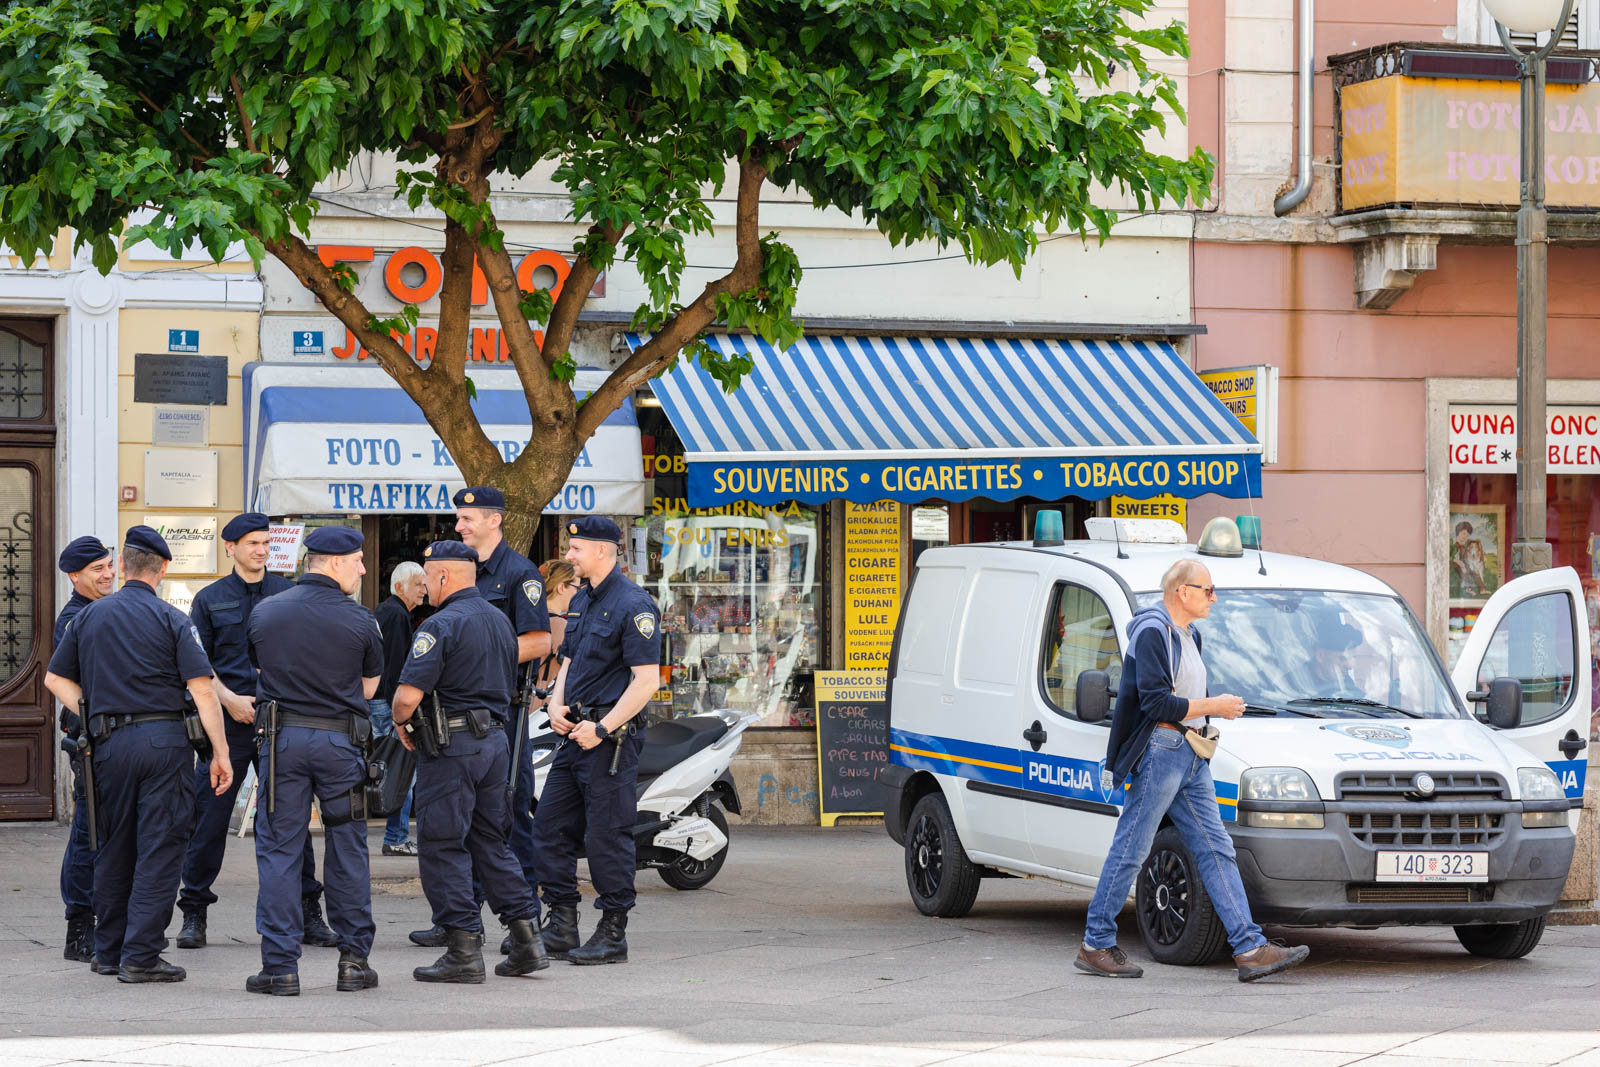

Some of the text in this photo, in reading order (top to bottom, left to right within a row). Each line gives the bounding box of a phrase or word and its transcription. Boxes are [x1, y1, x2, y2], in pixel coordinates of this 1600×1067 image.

[1344, 102, 1385, 136] FOTO
[1344, 152, 1386, 187] COPY
[180, 331, 187, 345] 1
[303, 332, 313, 346] 3
[1205, 377, 1254, 393] BACCO SHOP
[1451, 414, 1598, 435] VUNA ONC
[326, 438, 401, 466] FOTO
[1449, 444, 1498, 464] IGLE
[642, 454, 688, 473] TOB
[713, 461, 1239, 494] SOUVENIRS CIGARETTES TOBACCO SHOP
[329, 483, 452, 510] TRAFIKA
[1116, 503, 1179, 516] SWEETS
[849, 558, 896, 568] CIGARE
[849, 574, 896, 582] CIGARETE
[849, 587, 897, 595] E-CIGARETE
[854, 600, 893, 608] DUHANI
[696, 606, 750, 622] OPEN
[859, 615, 888, 624] LULE
[822, 677, 873, 685] TOBACCO
[848, 720, 886, 730] CIGARS
[828, 749, 858, 761] PIPE
[1334, 751, 1483, 761] POLICIJA
[839, 766, 870, 777] SNUS
[1028, 761, 1094, 791] POLICIJA
[1395, 855, 1473, 874] 140 323
